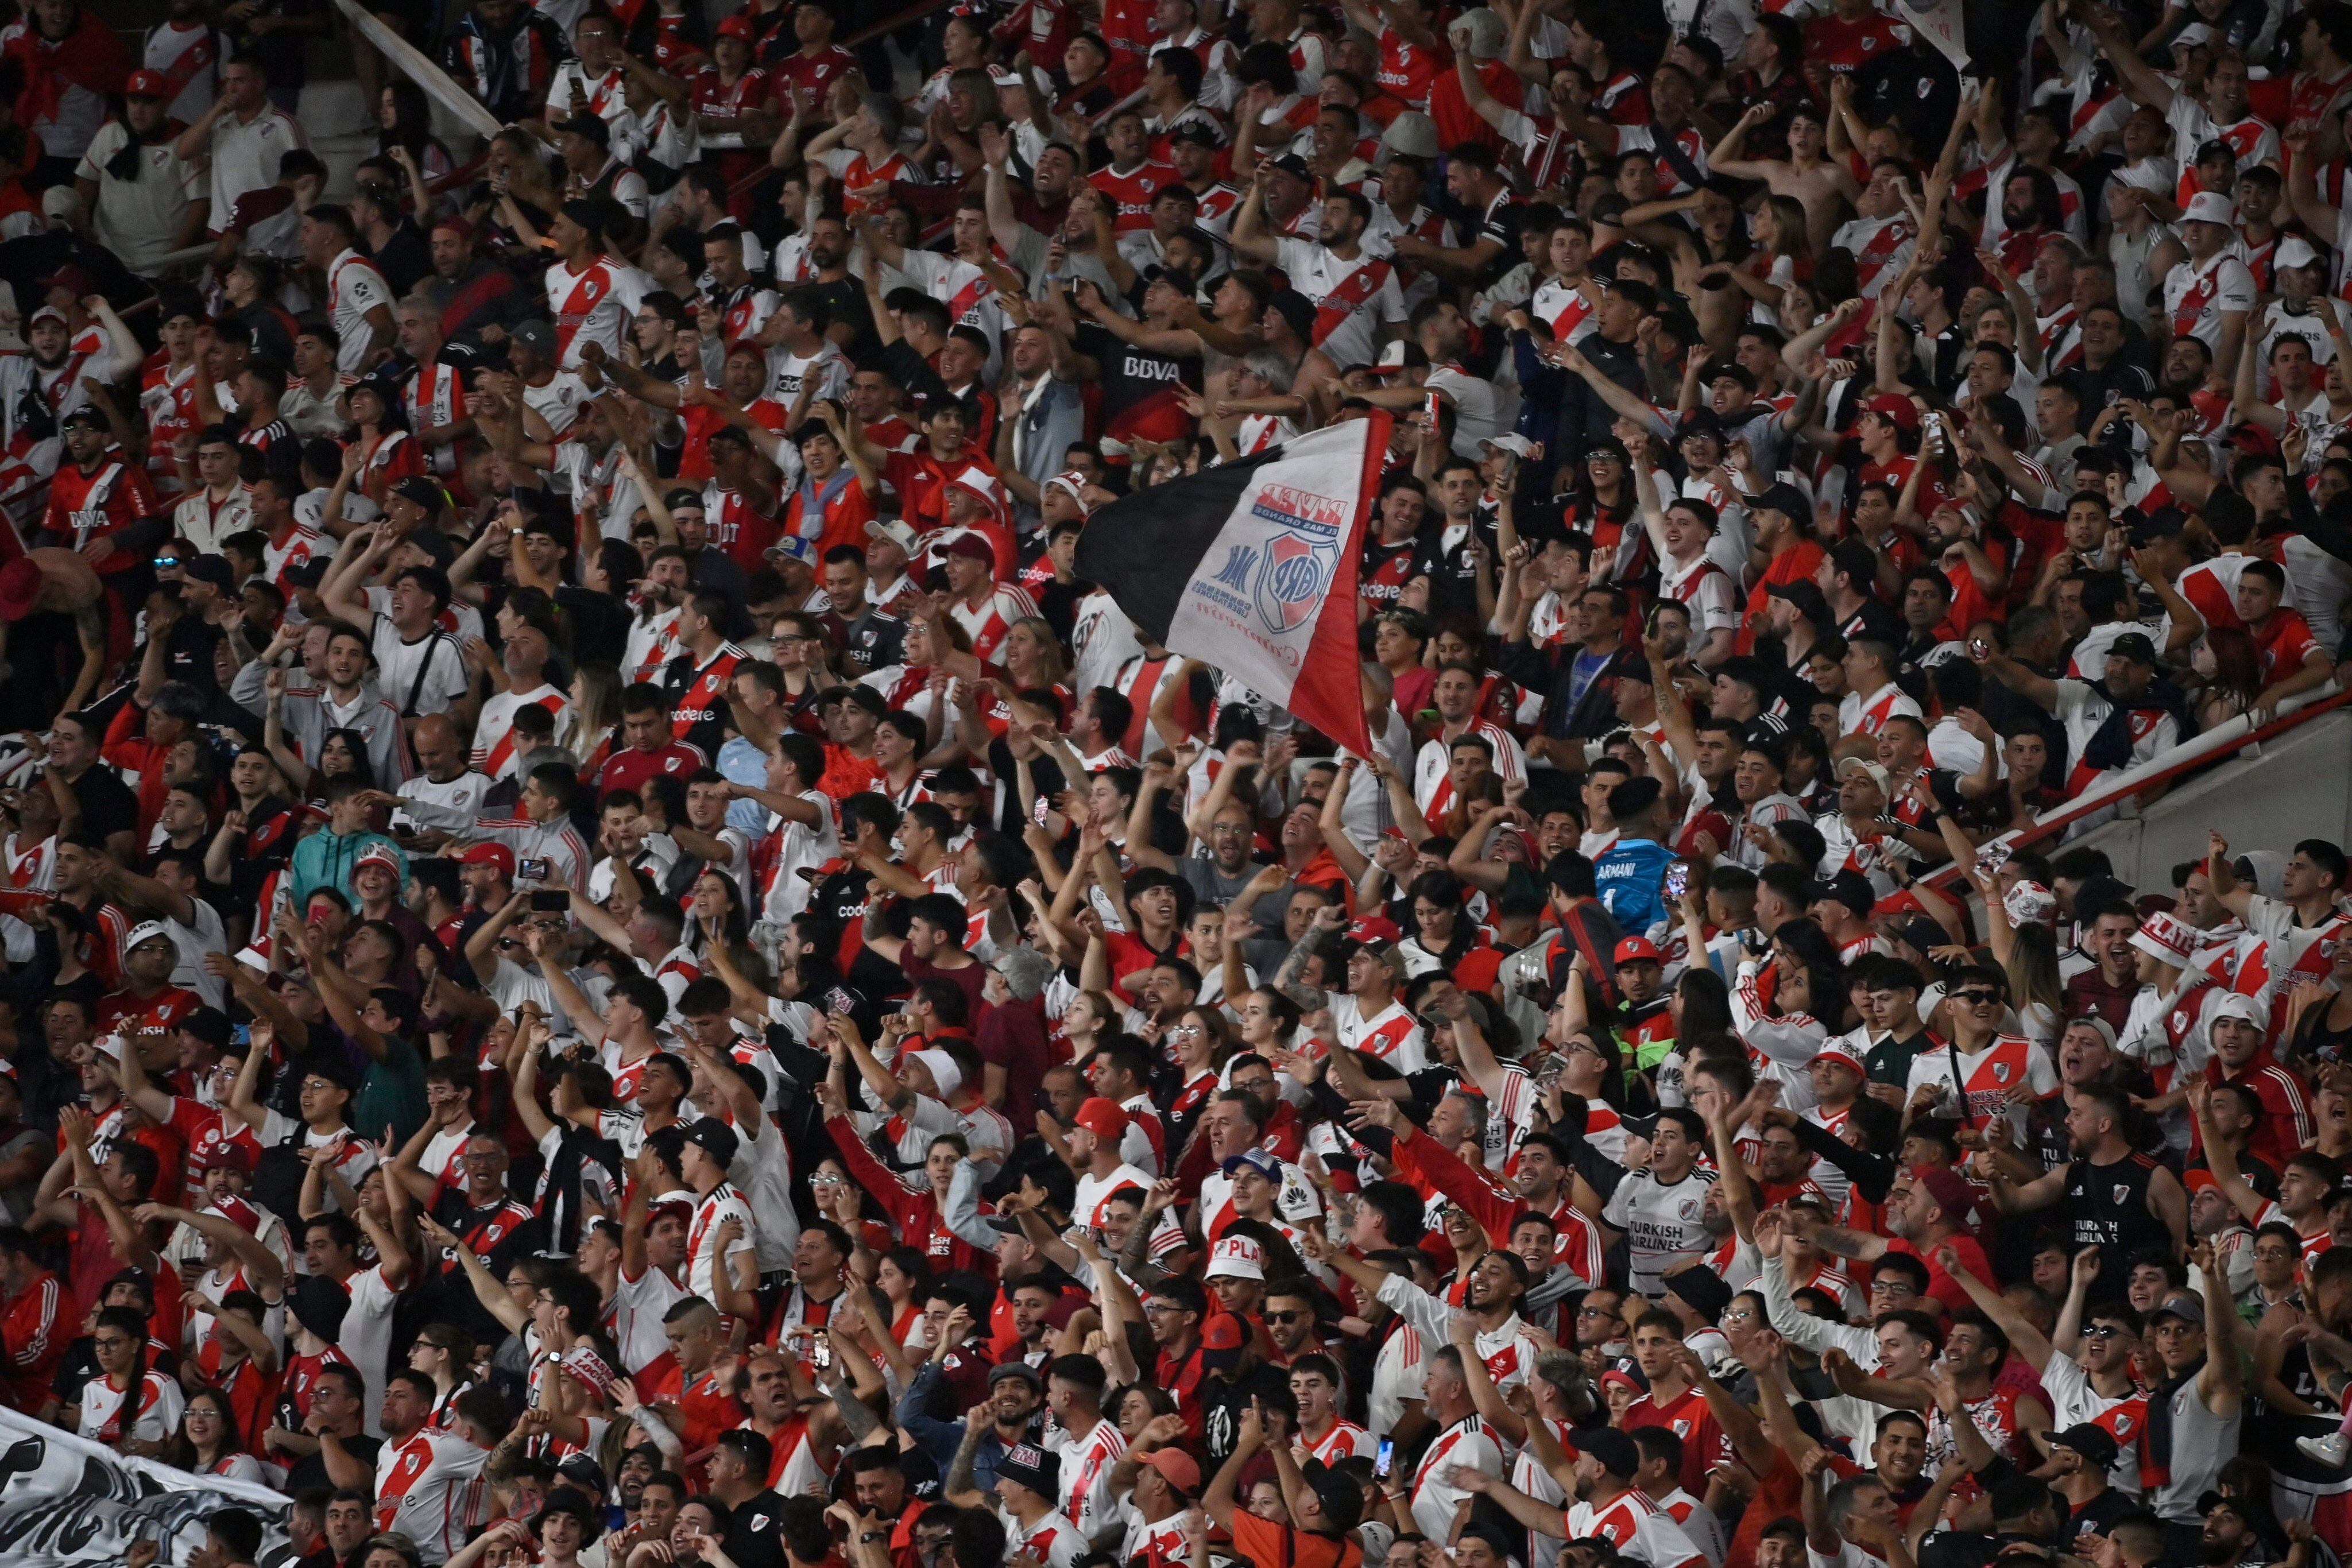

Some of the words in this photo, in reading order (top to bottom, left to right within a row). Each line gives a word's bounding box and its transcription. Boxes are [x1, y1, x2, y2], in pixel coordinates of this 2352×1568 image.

[1830, 63, 1855, 72] KISH
[1124, 357, 1180, 381] BBVA
[1597, 862, 1633, 880] ARMANI
[1630, 1220, 1683, 1239] TURKISH
[1228, 1239, 1263, 1261] PLA
